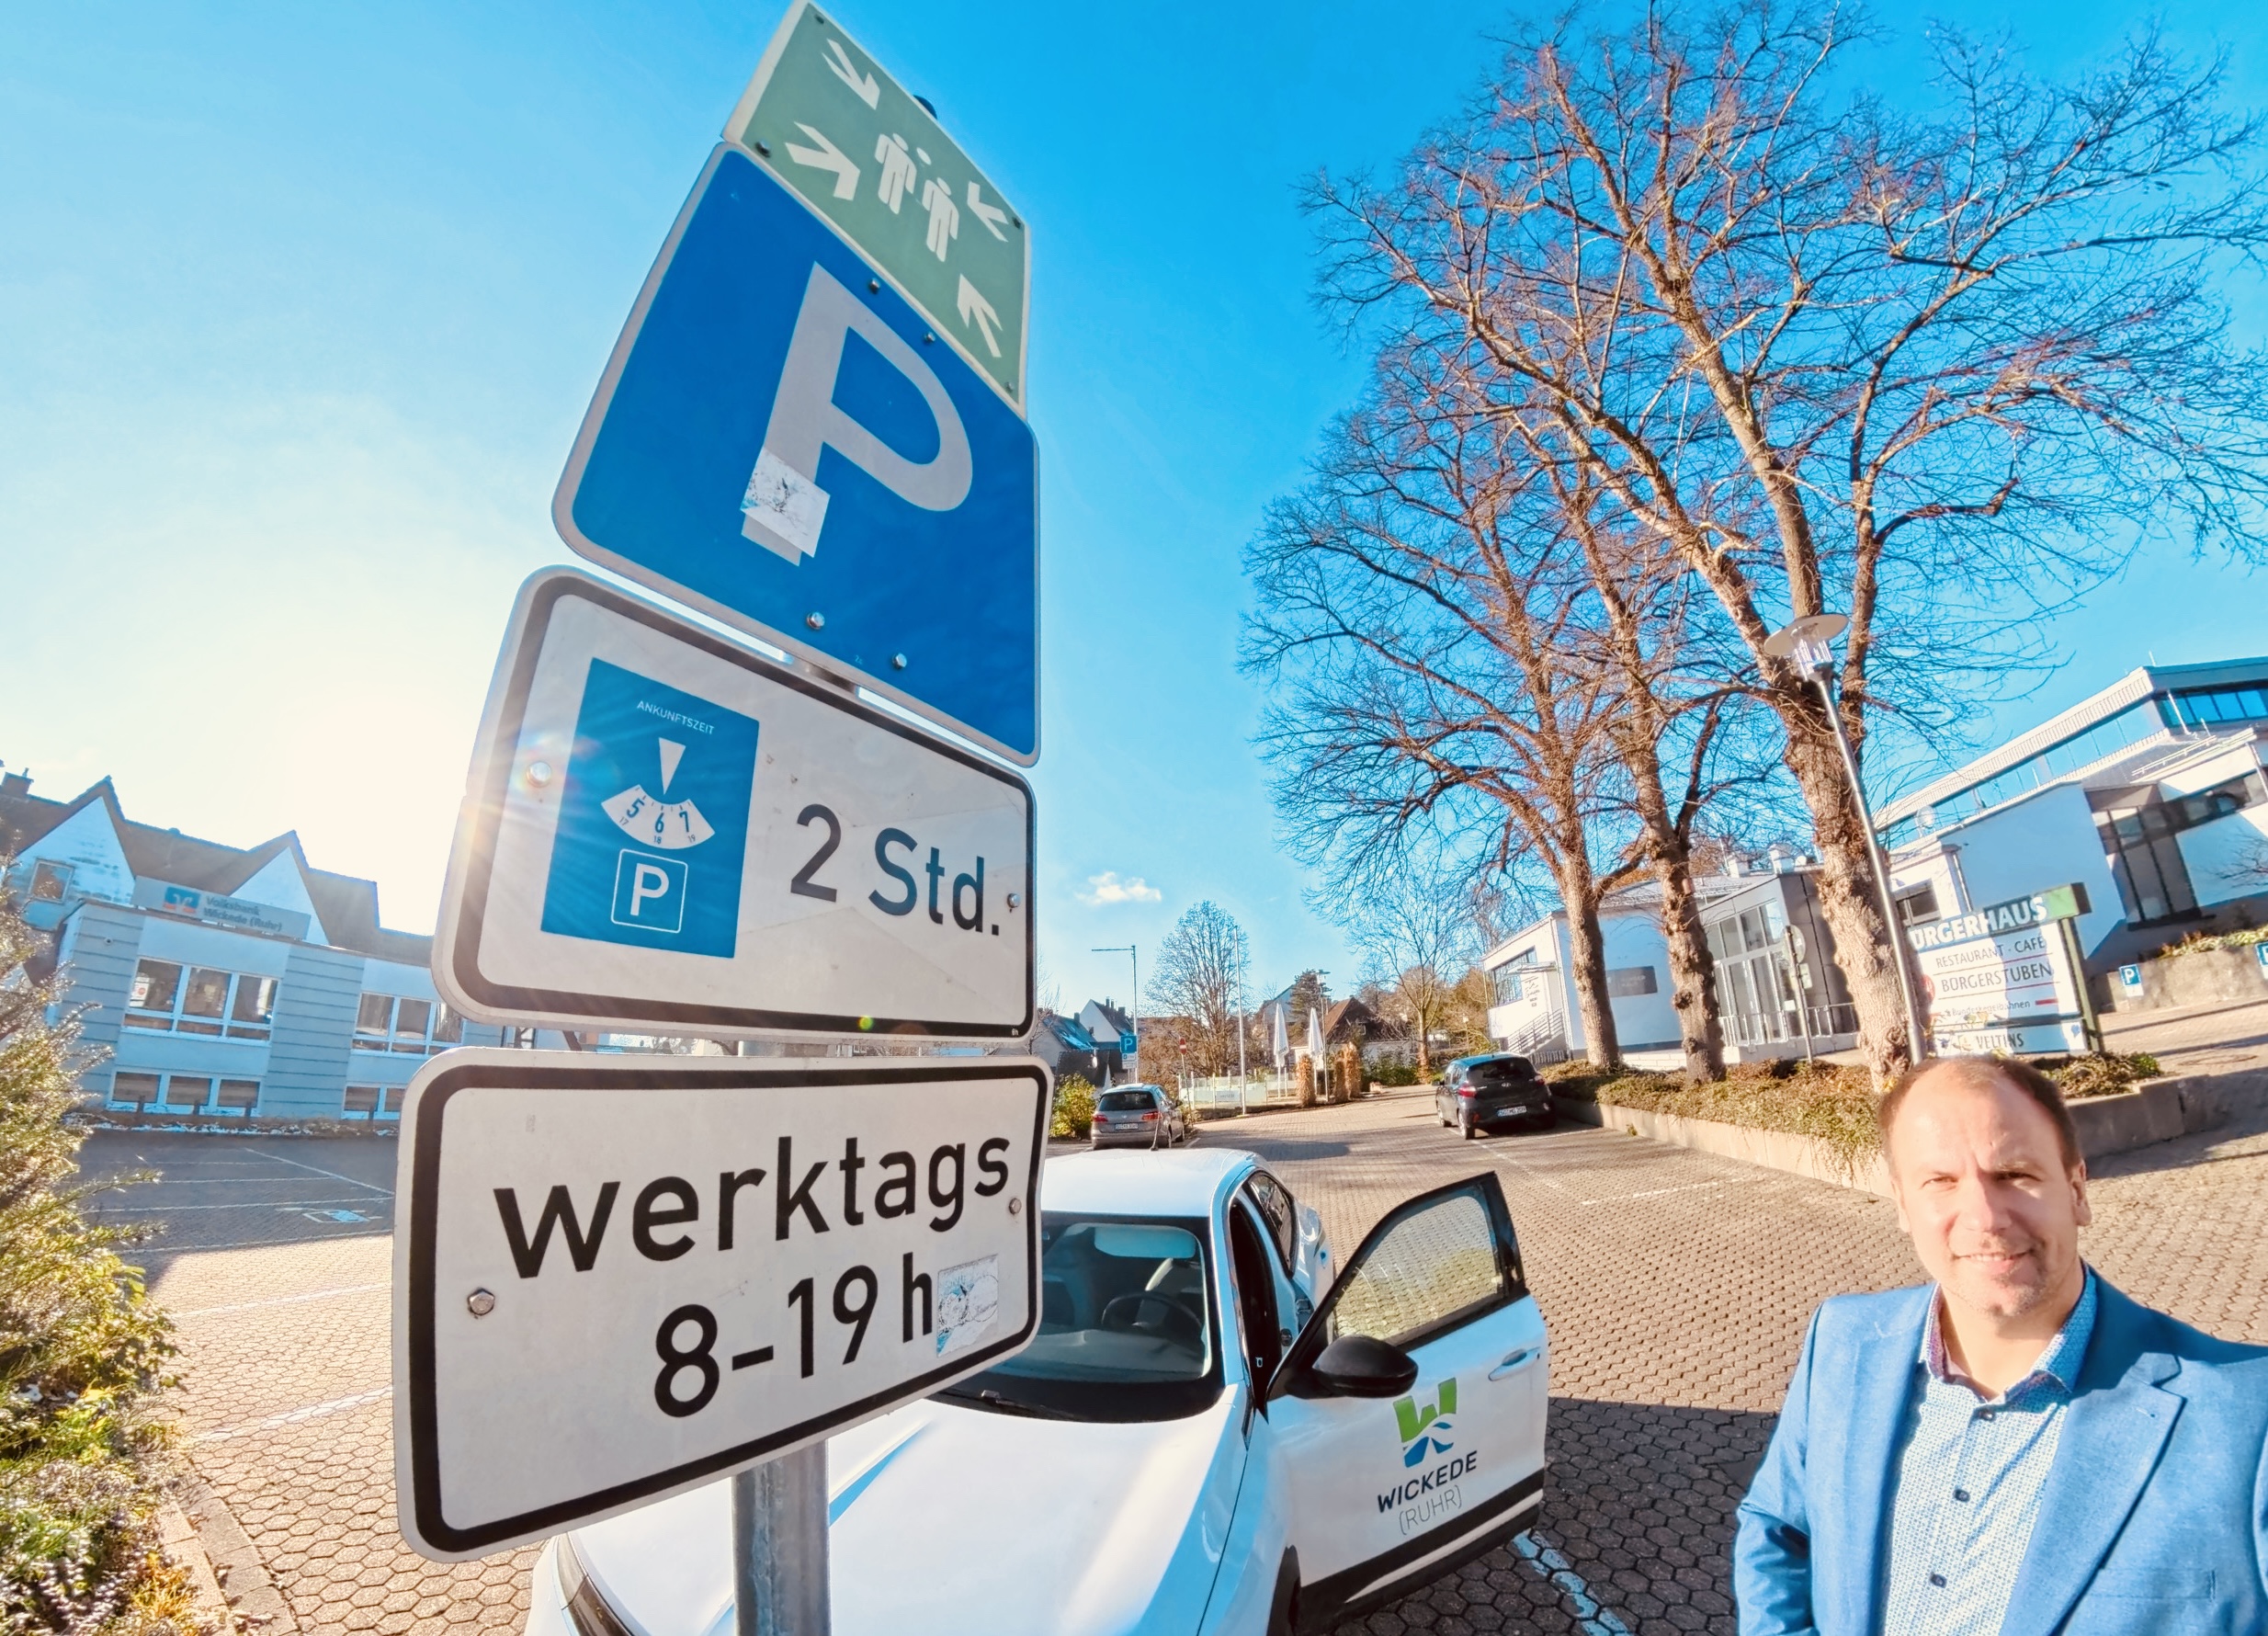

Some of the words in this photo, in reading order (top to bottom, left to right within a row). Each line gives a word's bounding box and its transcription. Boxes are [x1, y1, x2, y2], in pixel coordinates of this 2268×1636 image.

[741, 261, 973, 566] P
[636, 699, 715, 735] ANKUNFTSZEIT
[627, 798, 645, 819] 5
[654, 812, 664, 834] 6
[678, 811, 690, 833] 7
[629, 862, 670, 916] P
[790, 803, 842, 903] 2
[868, 827, 1000, 937] Std.
[1935, 944, 2004, 969] RESTAURANT
[2124, 968, 2135, 983] P
[1124, 1038, 1133, 1051] P
[1976, 1032, 2024, 1050] VELTINS
[493, 1135, 1011, 1278] werktags
[902, 1252, 934, 1344] h
[1377, 1449, 1478, 1514] WICKEDE
[1398, 1484, 1463, 1536] (RUHR)
